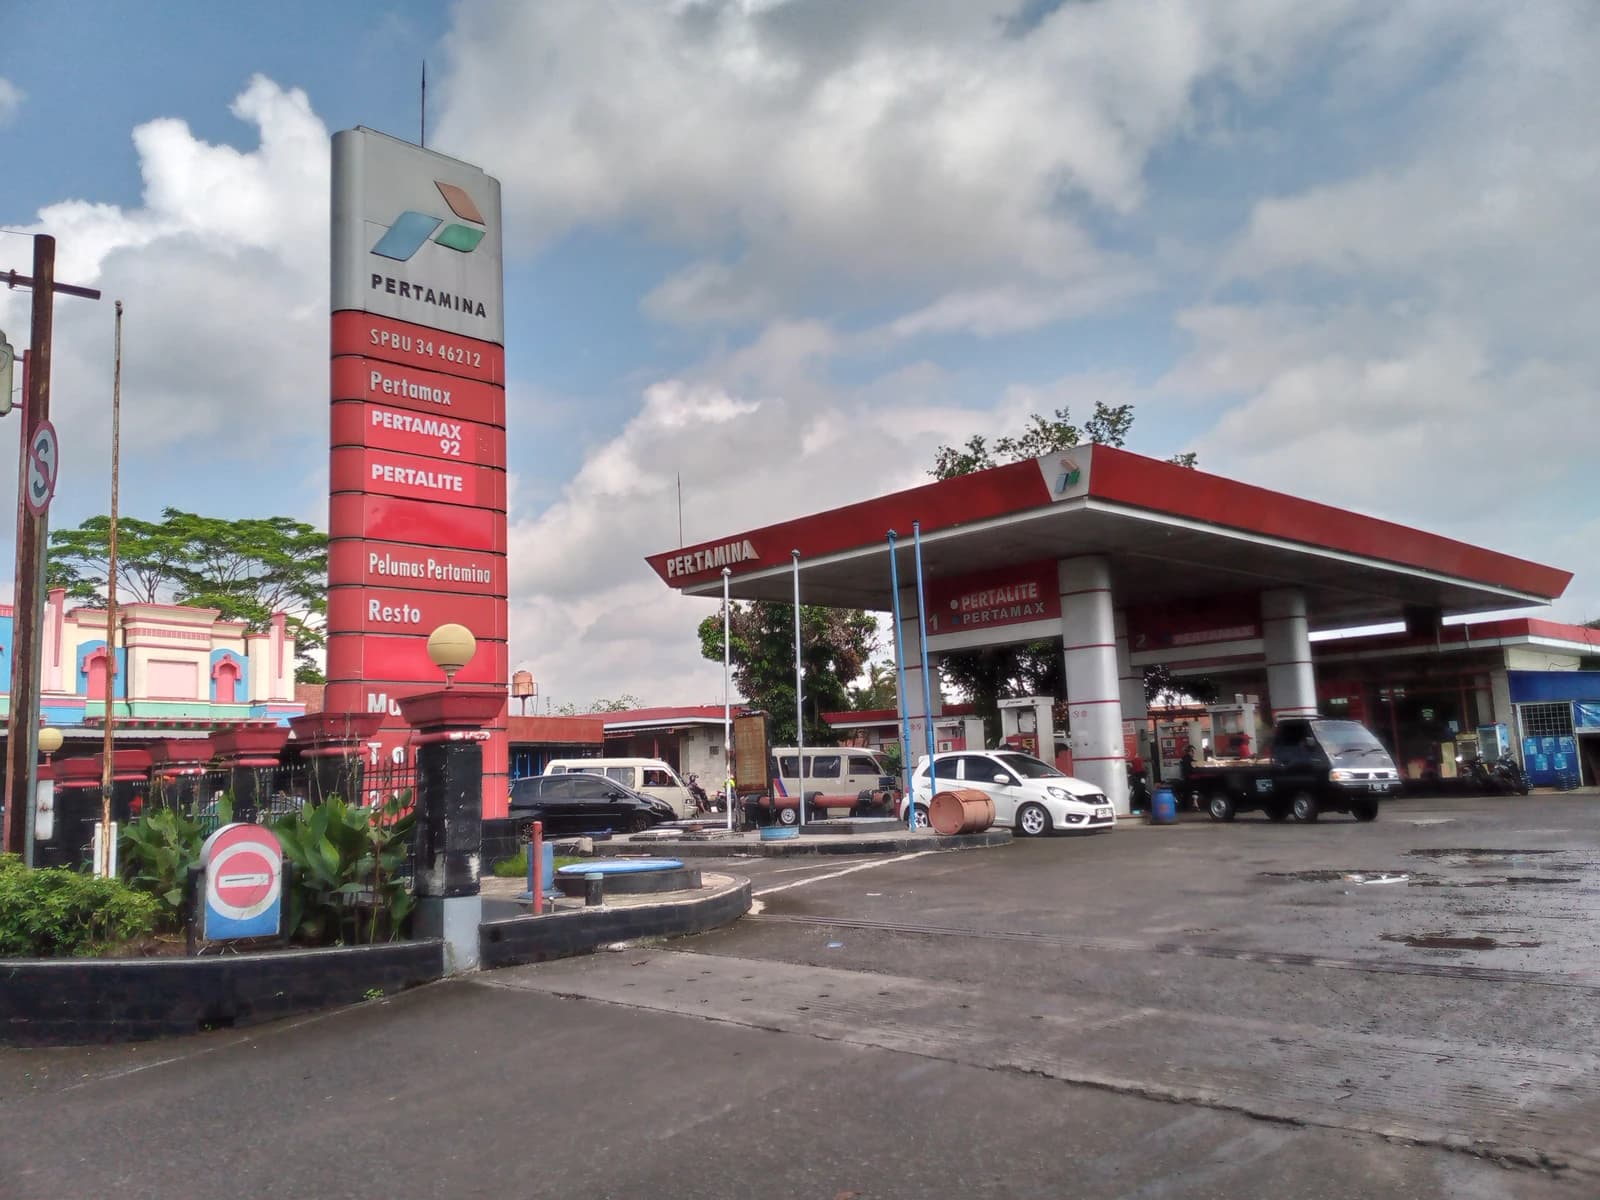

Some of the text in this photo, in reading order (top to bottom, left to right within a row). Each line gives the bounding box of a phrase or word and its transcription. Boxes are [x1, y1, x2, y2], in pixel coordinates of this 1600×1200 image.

[371, 273, 487, 318] PERTAMINA
[370, 328, 481, 368] SPBU 34 46212
[370, 371, 452, 406] Pertamax
[371, 410, 462, 440] PERTAMAX
[440, 439, 460, 456] 92
[371, 463, 463, 492] PERTALITE
[369, 552, 491, 583] Pelumas Pertamina
[667, 539, 760, 578] PERTAMINA
[961, 582, 1038, 610] PERTALITE
[368, 599, 421, 624] Resto
[929, 613, 939, 631] 1
[963, 601, 1046, 625] PERTAMAX
